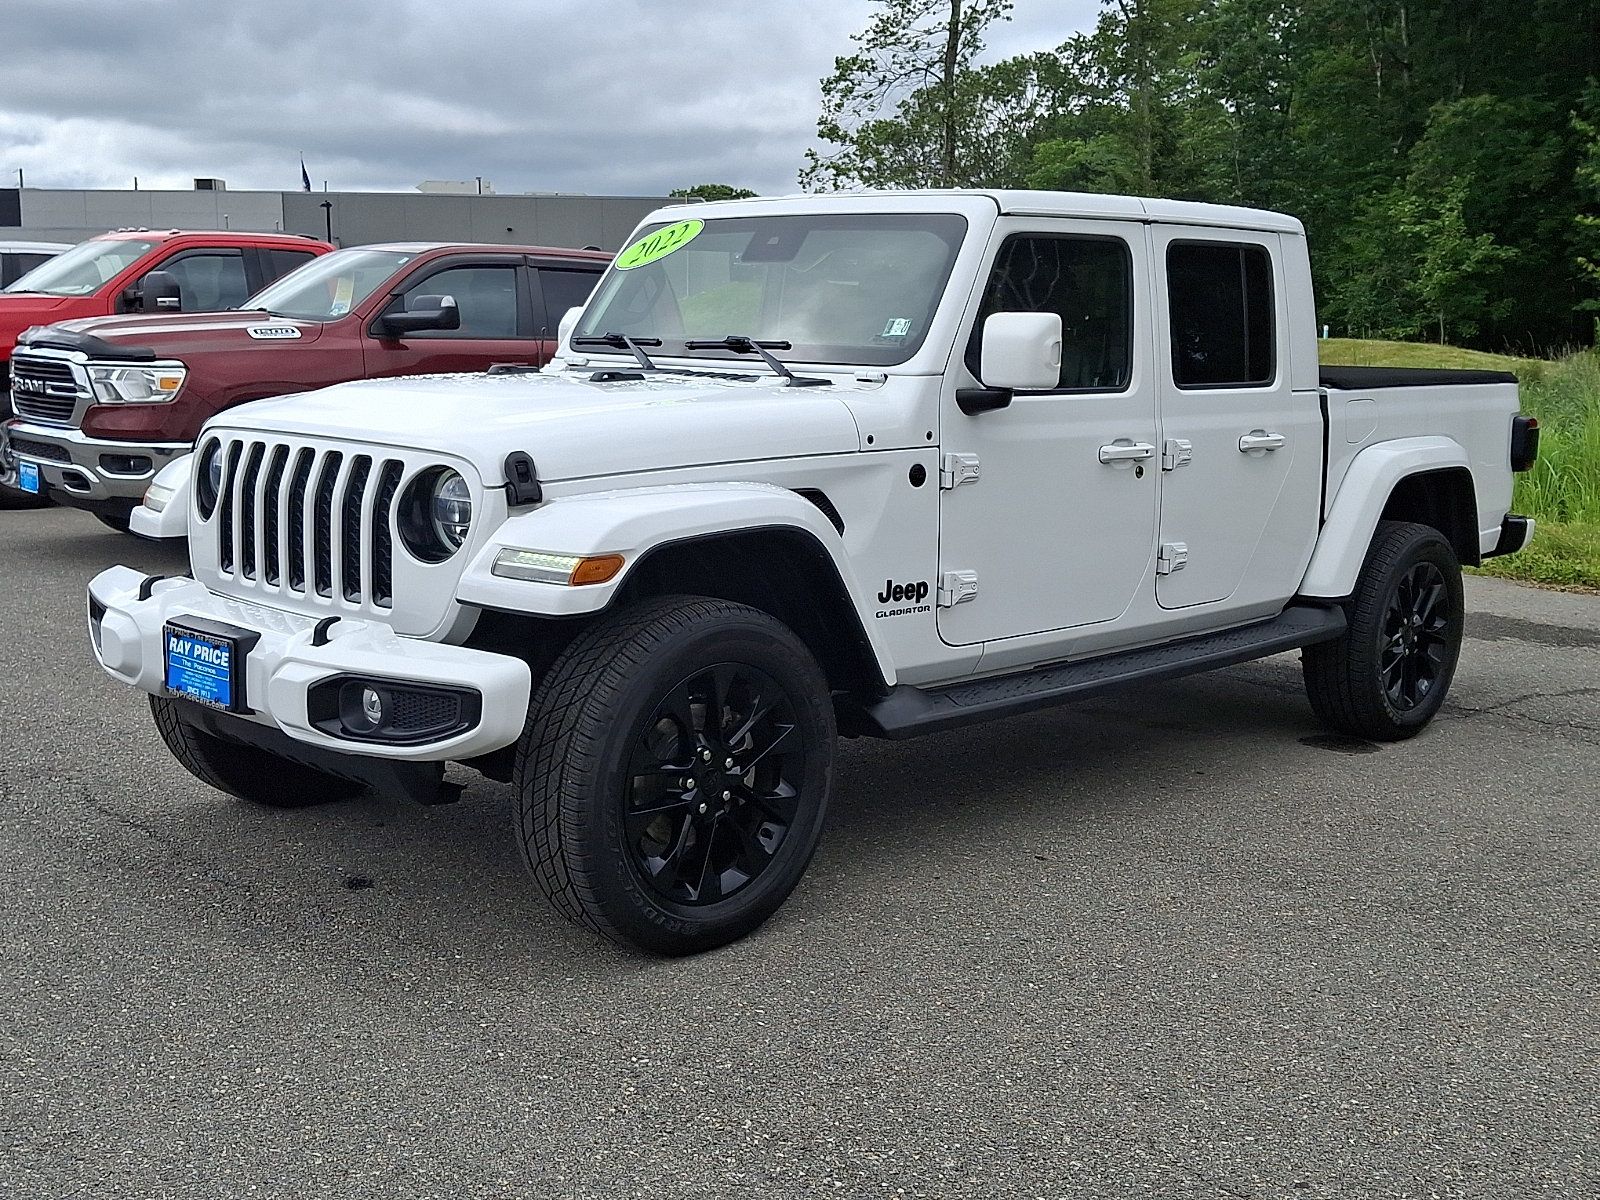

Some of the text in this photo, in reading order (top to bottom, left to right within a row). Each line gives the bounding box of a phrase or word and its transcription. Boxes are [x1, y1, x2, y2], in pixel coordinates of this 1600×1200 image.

[629, 223, 690, 265] 2022
[14, 377, 44, 393] RAM
[878, 579, 929, 604] Jeep
[875, 605, 931, 619] GLADIATOR
[169, 637, 229, 666] RAY PRICE
[181, 658, 216, 674] The Poconos
